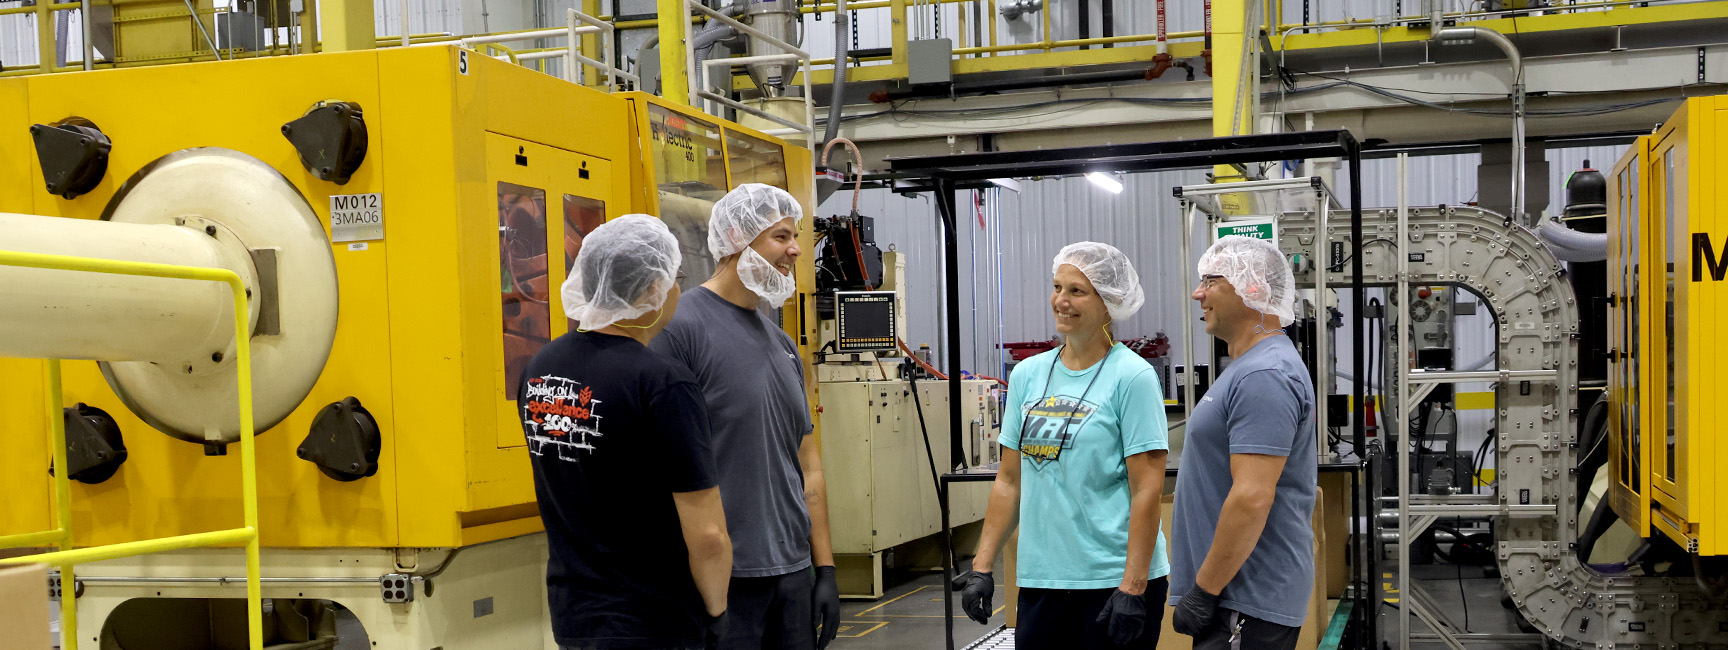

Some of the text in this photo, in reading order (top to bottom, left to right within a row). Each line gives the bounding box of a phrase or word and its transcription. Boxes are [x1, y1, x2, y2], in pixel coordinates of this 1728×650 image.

[460, 51, 467, 73] 5
[334, 194, 378, 210] M012
[1232, 225, 1259, 233] THINK
[1022, 444, 1061, 459] CHAMPS
